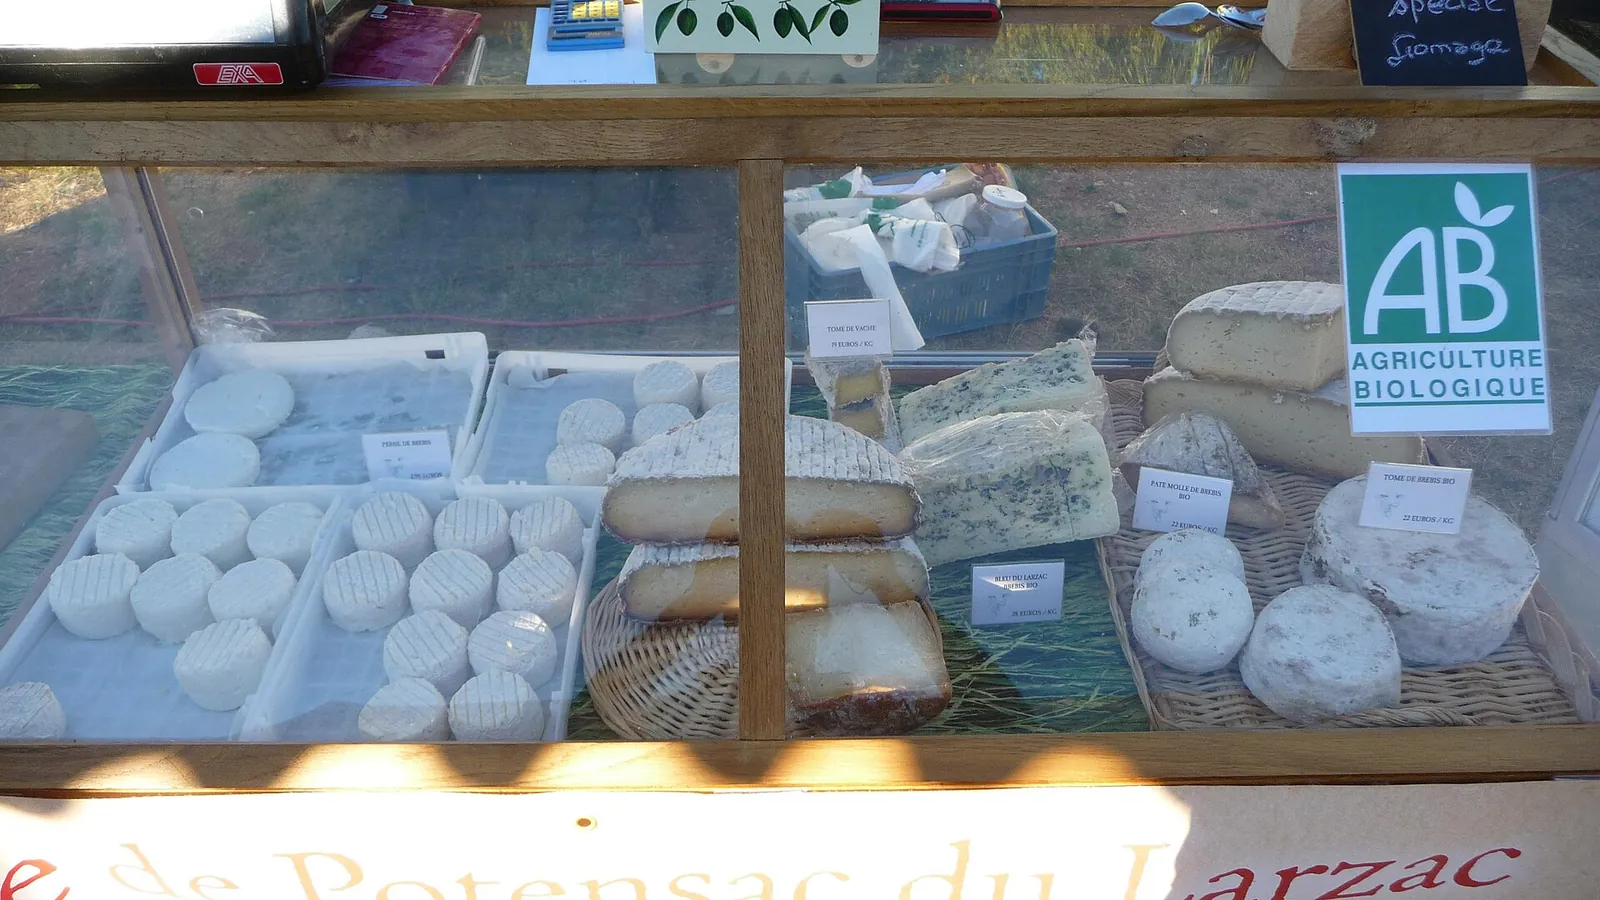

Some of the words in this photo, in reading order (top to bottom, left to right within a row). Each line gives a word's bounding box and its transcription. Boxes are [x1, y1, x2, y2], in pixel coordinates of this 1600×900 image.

[216, 65, 264, 84] EXA
[1363, 226, 1508, 335] AB
[1352, 348, 1543, 371] AGRICULTURE
[1355, 377, 1545, 400] BIOLOGIQUE
[1383, 473, 1405, 482] TOME
[1406, 474, 1417, 482] DE
[1417, 476, 1441, 484] BREBIS
[1441, 477, 1456, 485] BIO
[1150, 480, 1166, 489] PATE
[1167, 482, 1189, 492] MOLLE
[1190, 486, 1201, 494] DE
[1200, 487, 1222, 497] BREBIS
[1178, 493, 1191, 501] BIO
[1411, 515, 1436, 523] EUROS
[1442, 516, 1454, 524] KG
[1012, 573, 1023, 581] DU
[1023, 573, 1048, 581] LARZAC
[108, 843, 240, 900] de
[900, 840, 1055, 900] du
